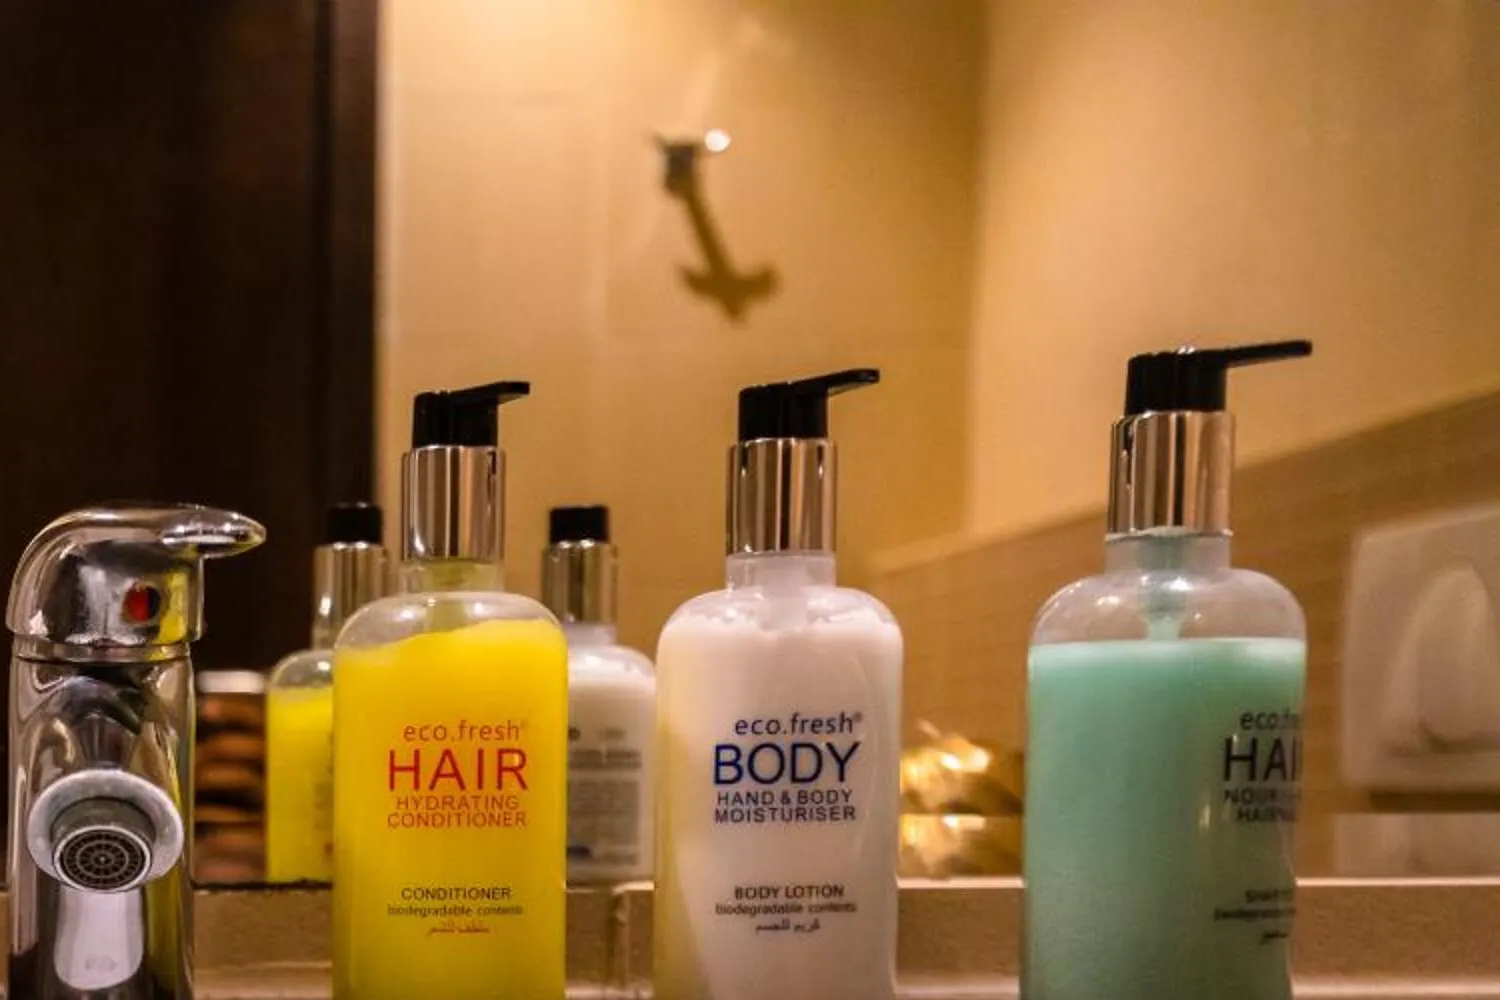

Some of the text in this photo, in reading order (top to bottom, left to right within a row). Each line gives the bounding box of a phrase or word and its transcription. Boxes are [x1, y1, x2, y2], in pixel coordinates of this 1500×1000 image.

[713, 742, 861, 786] BODY
[1223, 736, 1304, 782] HAI
[388, 748, 529, 792] HAIR
[395, 795, 520, 811] HYDRATING
[717, 788, 853, 806] HAND & BODY
[387, 810, 527, 829] CONDITIONER
[715, 805, 857, 824] MOISTURISER
[401, 887, 513, 901] CONDITIONER
[734, 884, 845, 900] BODY LOTION
